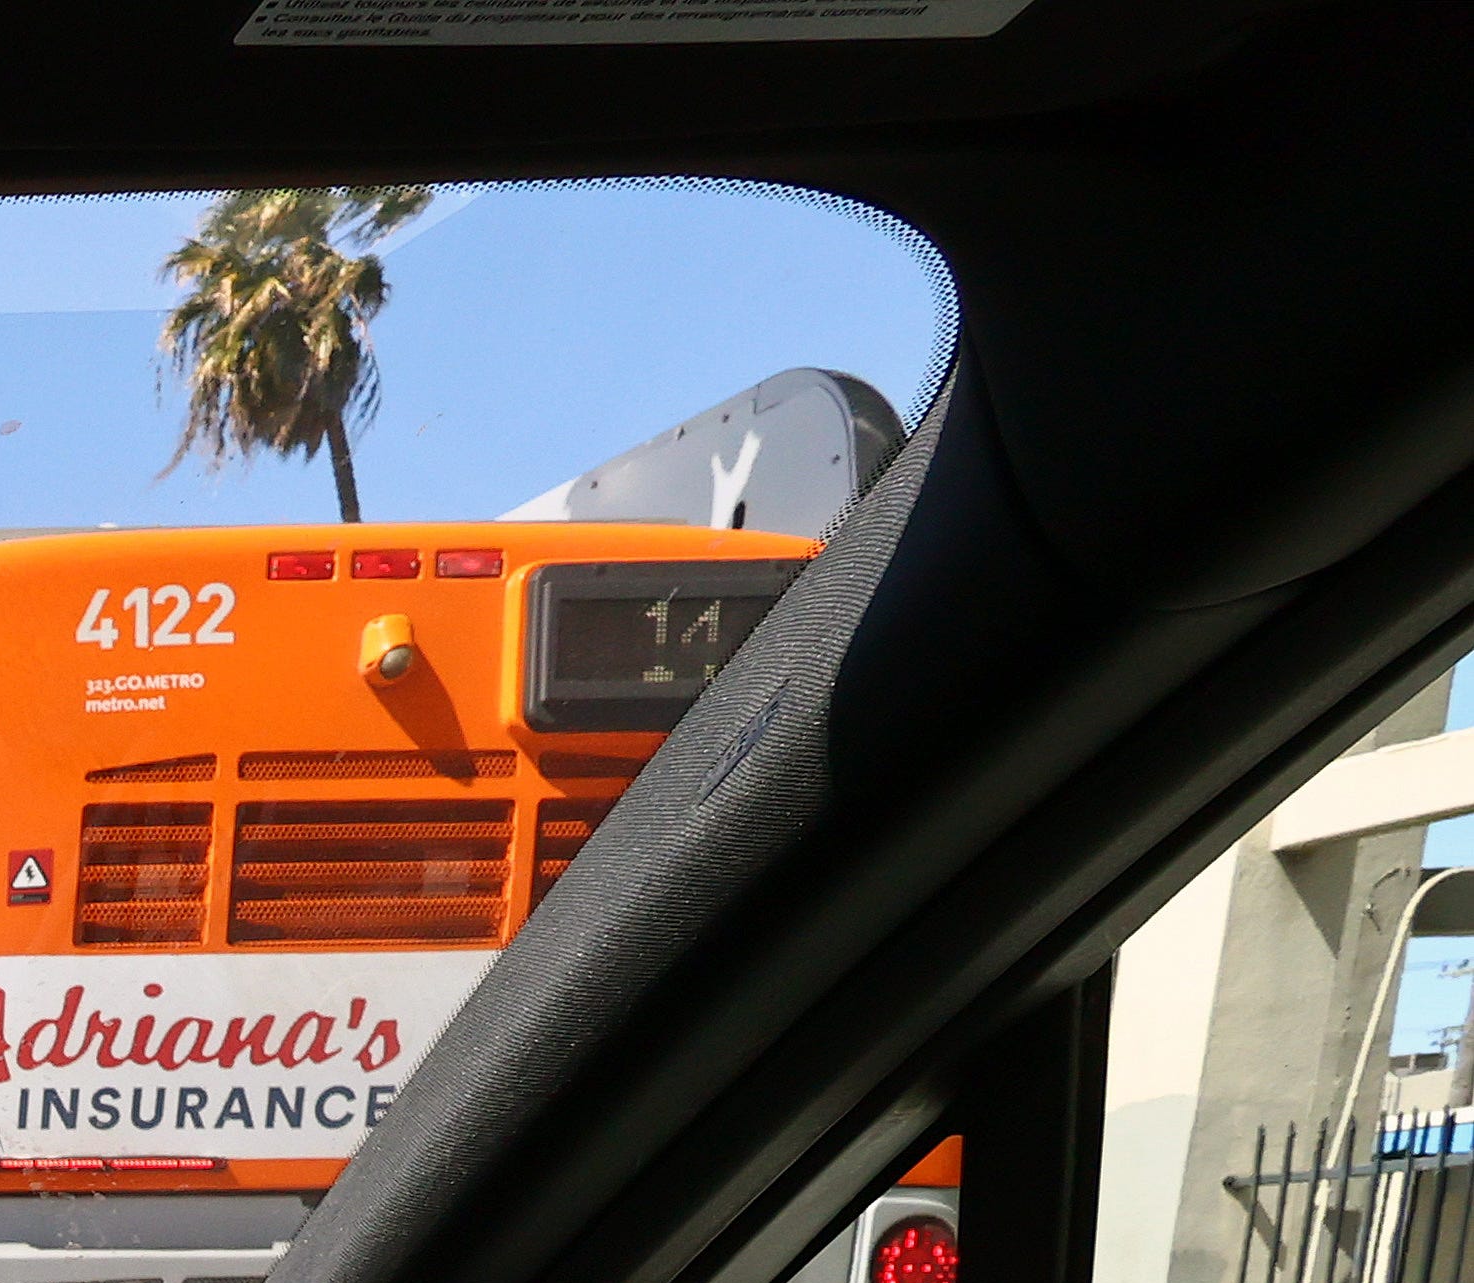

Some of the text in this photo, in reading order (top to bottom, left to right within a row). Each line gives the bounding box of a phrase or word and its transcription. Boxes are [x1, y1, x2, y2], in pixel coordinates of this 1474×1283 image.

[76, 582, 236, 649] 4122
[86, 673, 205, 694] 323.GO.METRO
[86, 696, 166, 713] metro.net
[17, 1084, 397, 1130] INSURANCE
